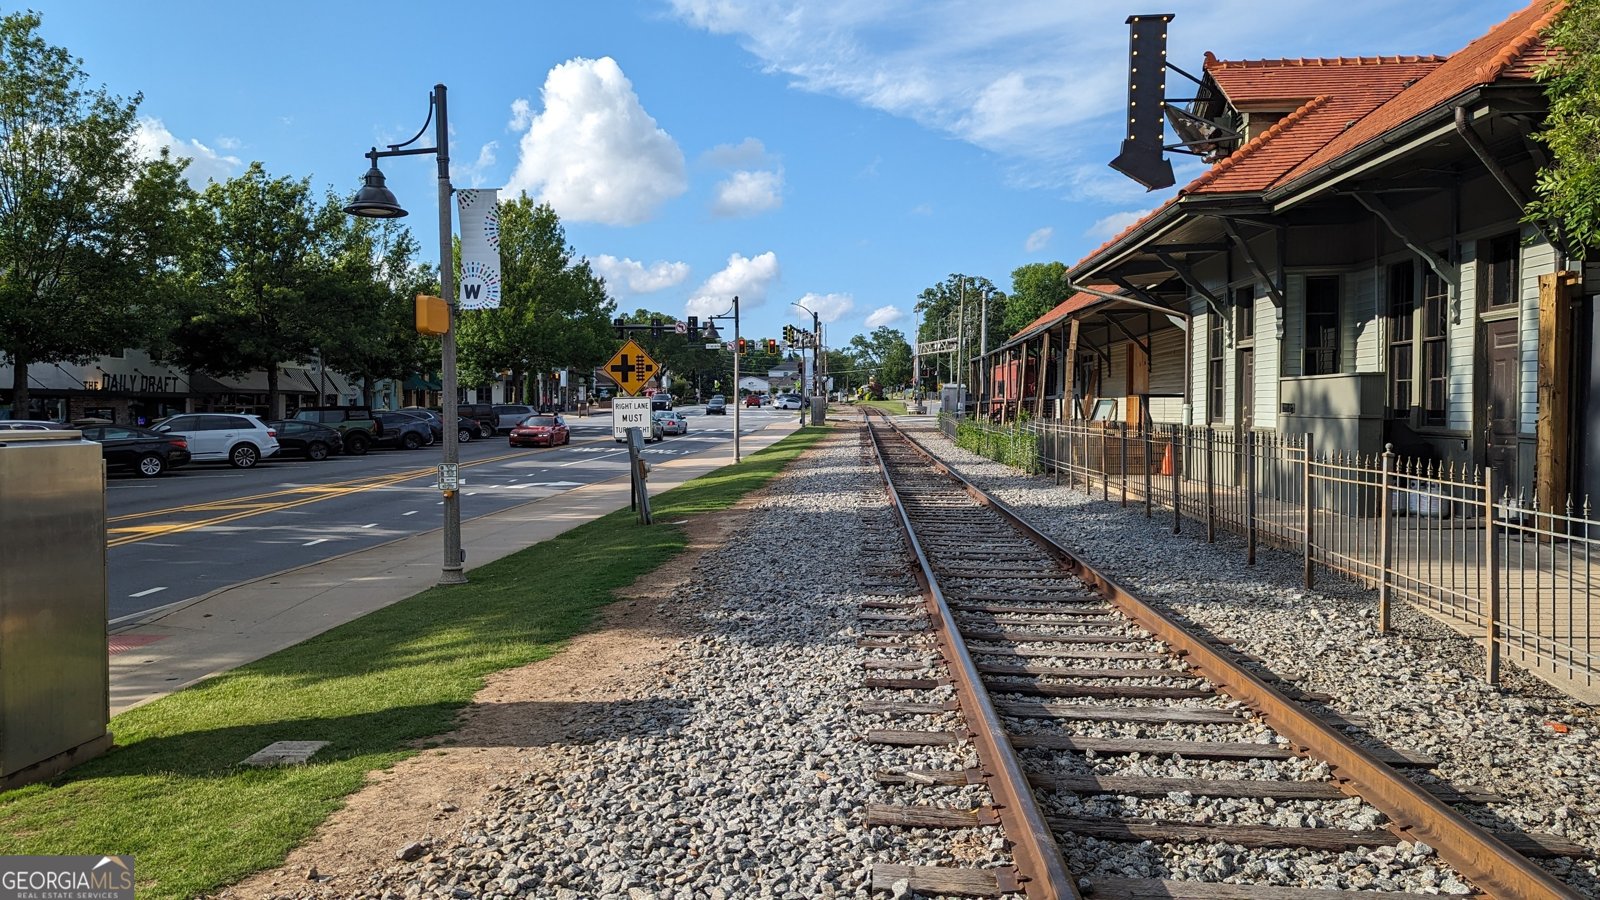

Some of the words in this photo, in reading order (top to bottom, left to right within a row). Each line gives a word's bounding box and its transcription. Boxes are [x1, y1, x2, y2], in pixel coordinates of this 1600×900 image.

[464, 284, 481, 299] W
[83, 381, 99, 390] THE
[102, 374, 137, 391] DAILY
[141, 375, 179, 392] DRAFT
[615, 402, 632, 410] RIGHT
[634, 402, 649, 410] LANE
[622, 413, 642, 422] MUST
